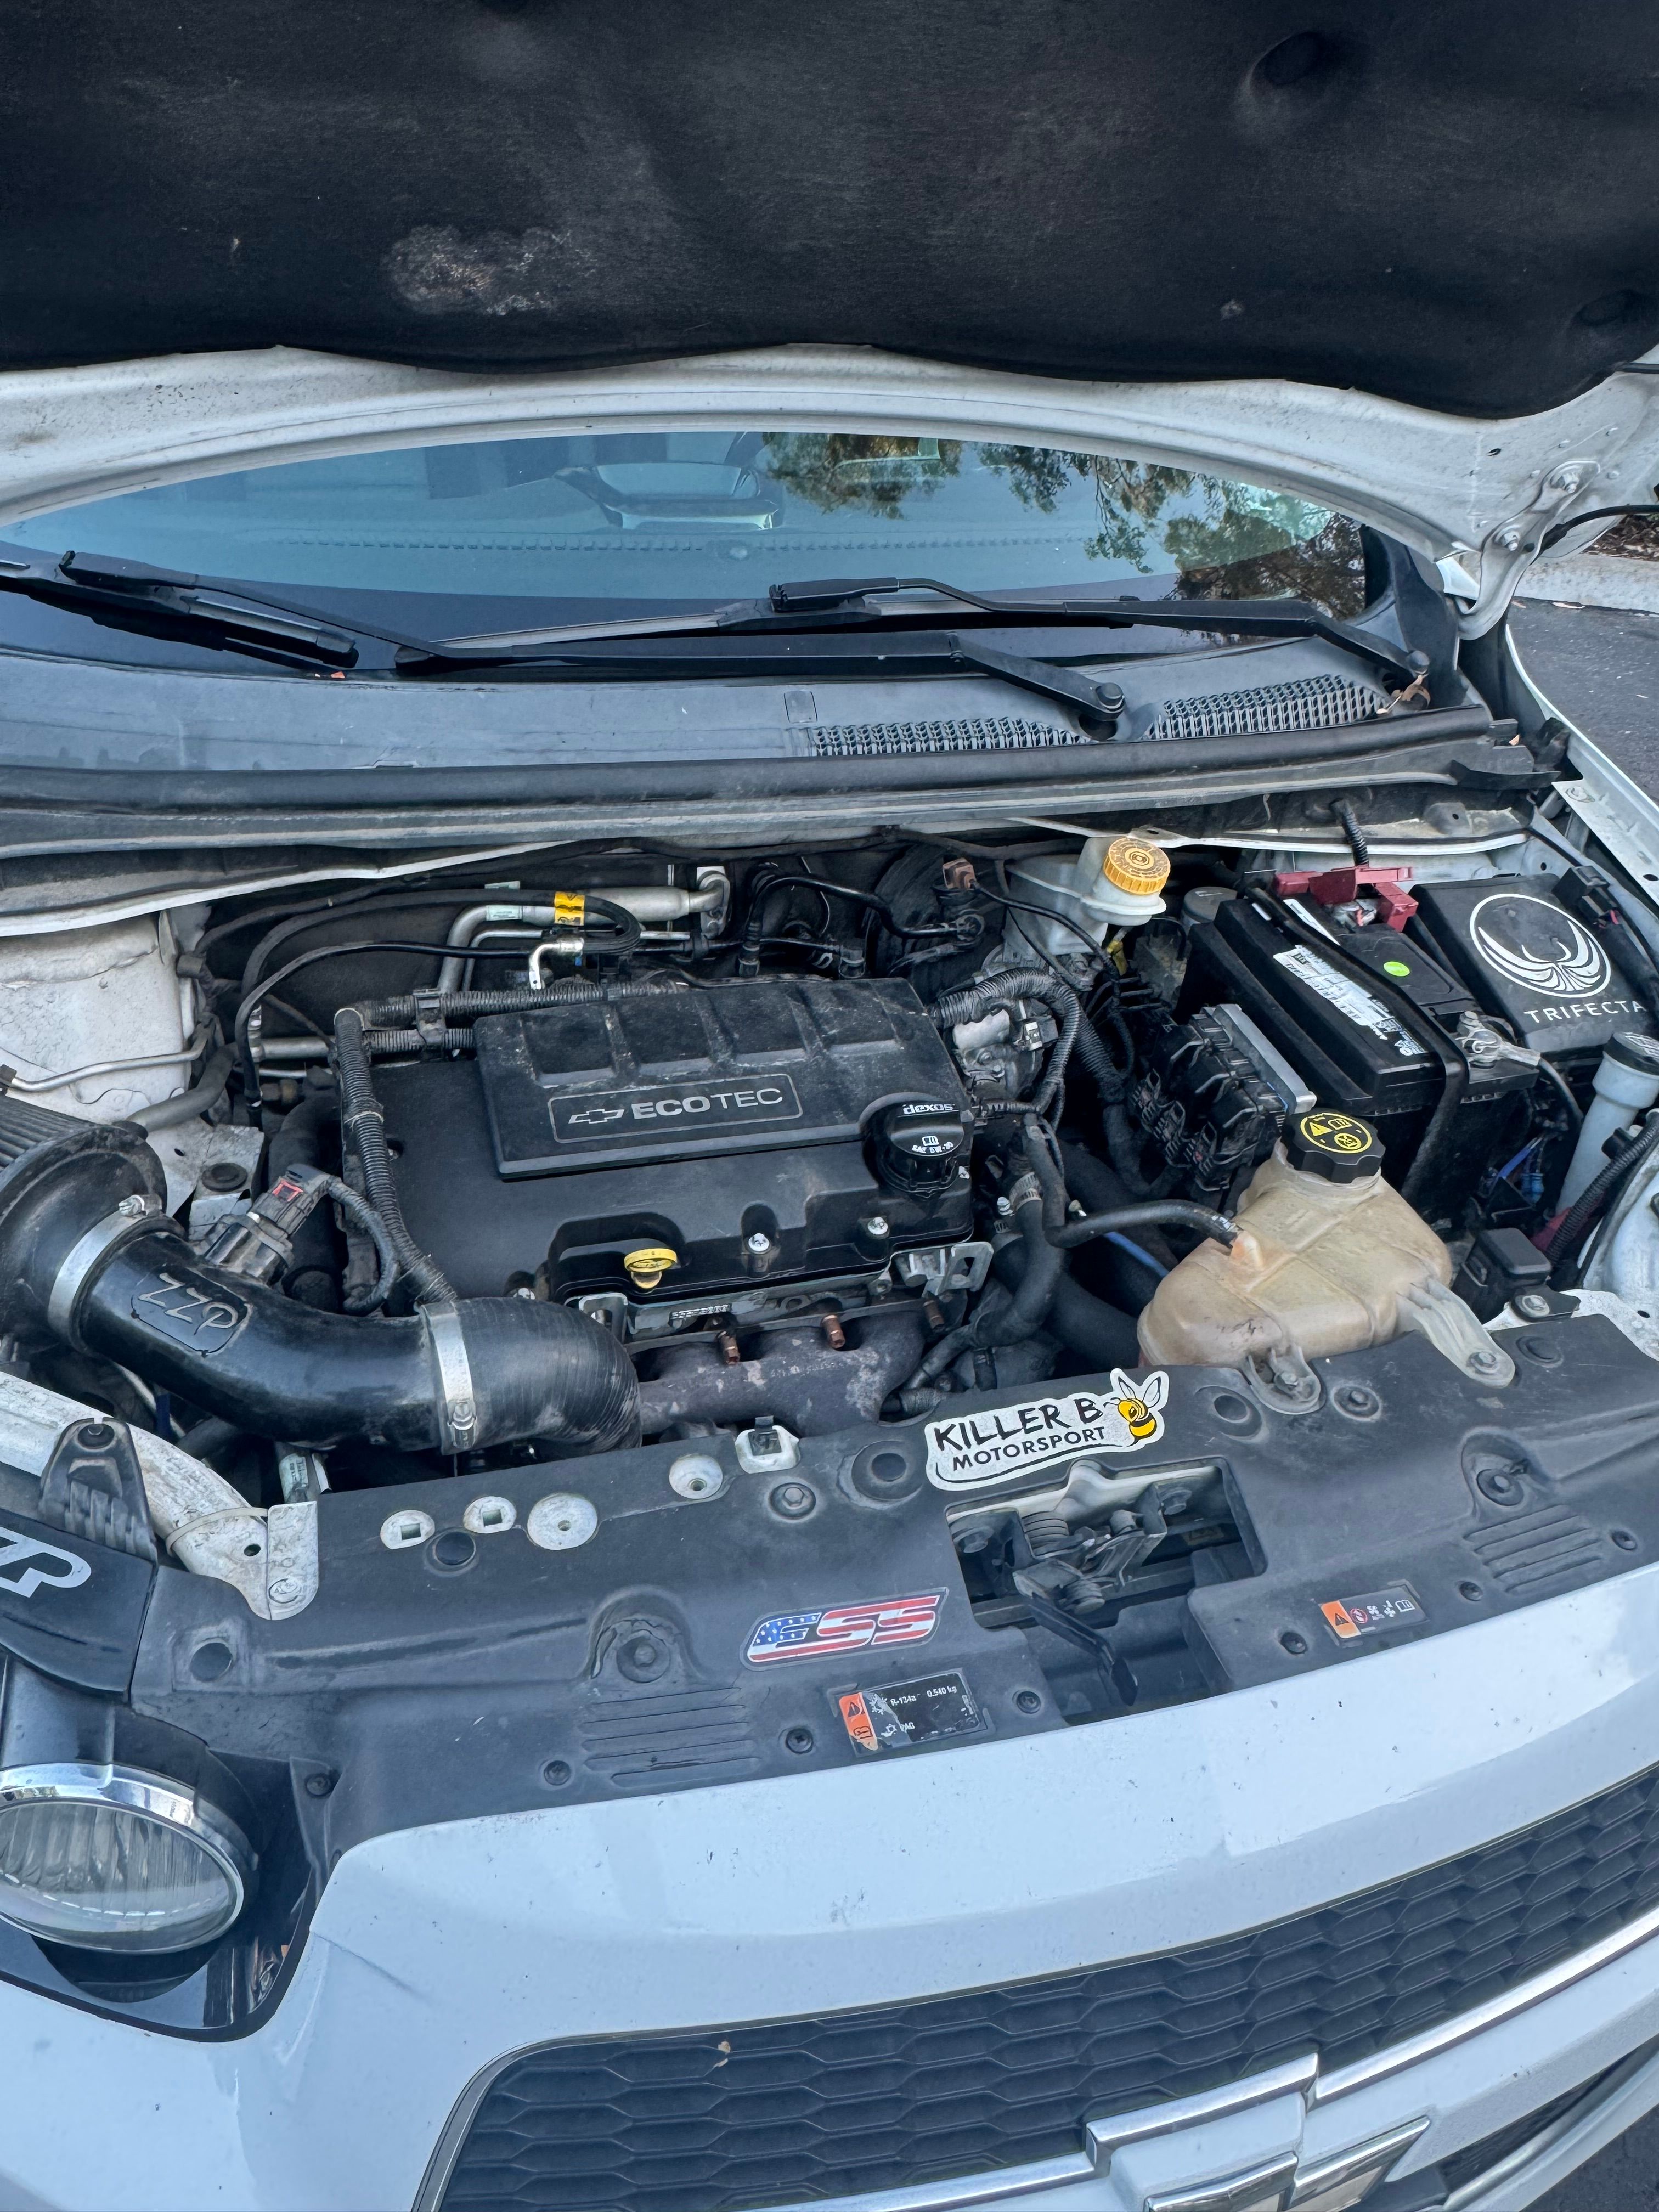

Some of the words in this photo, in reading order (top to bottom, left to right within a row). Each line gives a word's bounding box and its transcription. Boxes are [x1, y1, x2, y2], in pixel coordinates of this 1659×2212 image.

[1523, 1000, 1647, 1023] TRIFECTA
[631, 1088, 783, 1120] ECOTEC
[902, 1103, 954, 1115] dexos
[138, 1272, 238, 1336] ZZP
[933, 1404, 1072, 1452] KILLER
[1074, 1397, 1103, 1424] B
[953, 1426, 1105, 1472] MOTORSPORT
[747, 1594, 940, 1663] ESS
